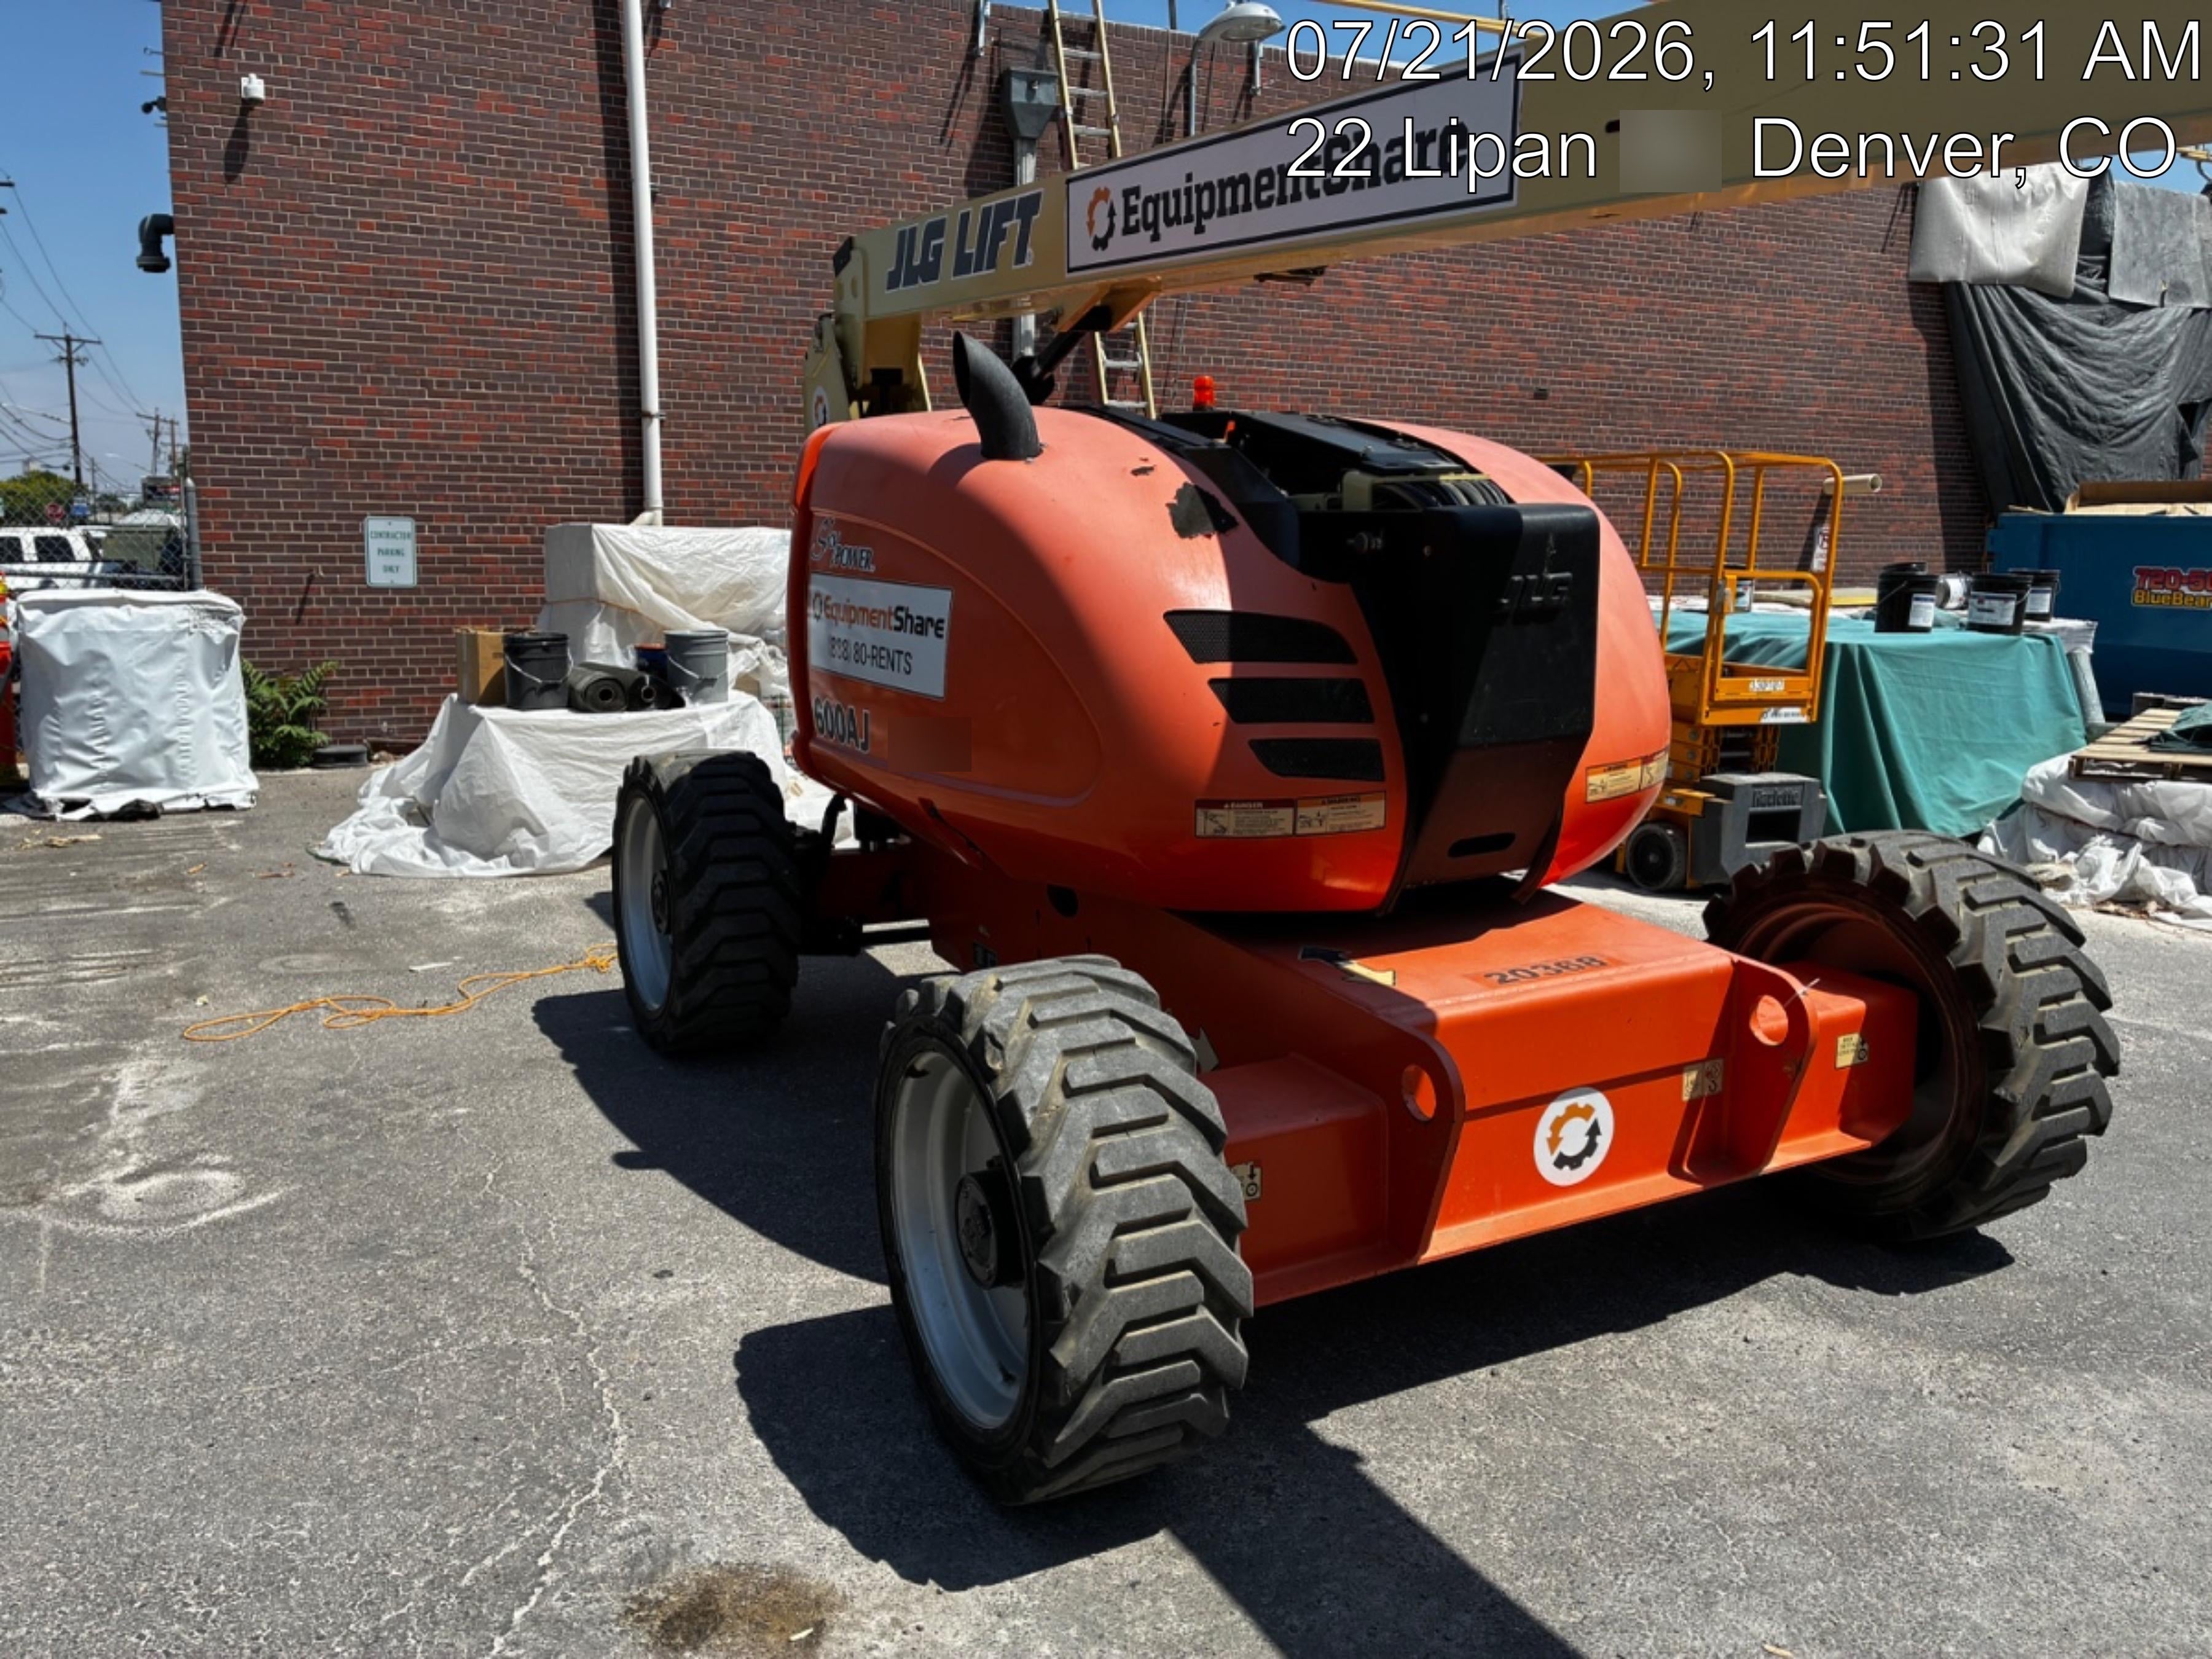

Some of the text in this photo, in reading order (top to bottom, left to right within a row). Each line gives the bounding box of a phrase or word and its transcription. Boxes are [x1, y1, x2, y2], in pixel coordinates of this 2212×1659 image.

[1121, 121, 1469, 242] EquipmentShare
[885, 187, 1045, 293] JLG LIFT
[824, 595, 945, 639] EquipmentShare
[853, 641, 913, 675] 80-RENTS
[814, 697, 870, 754] 600AJ
